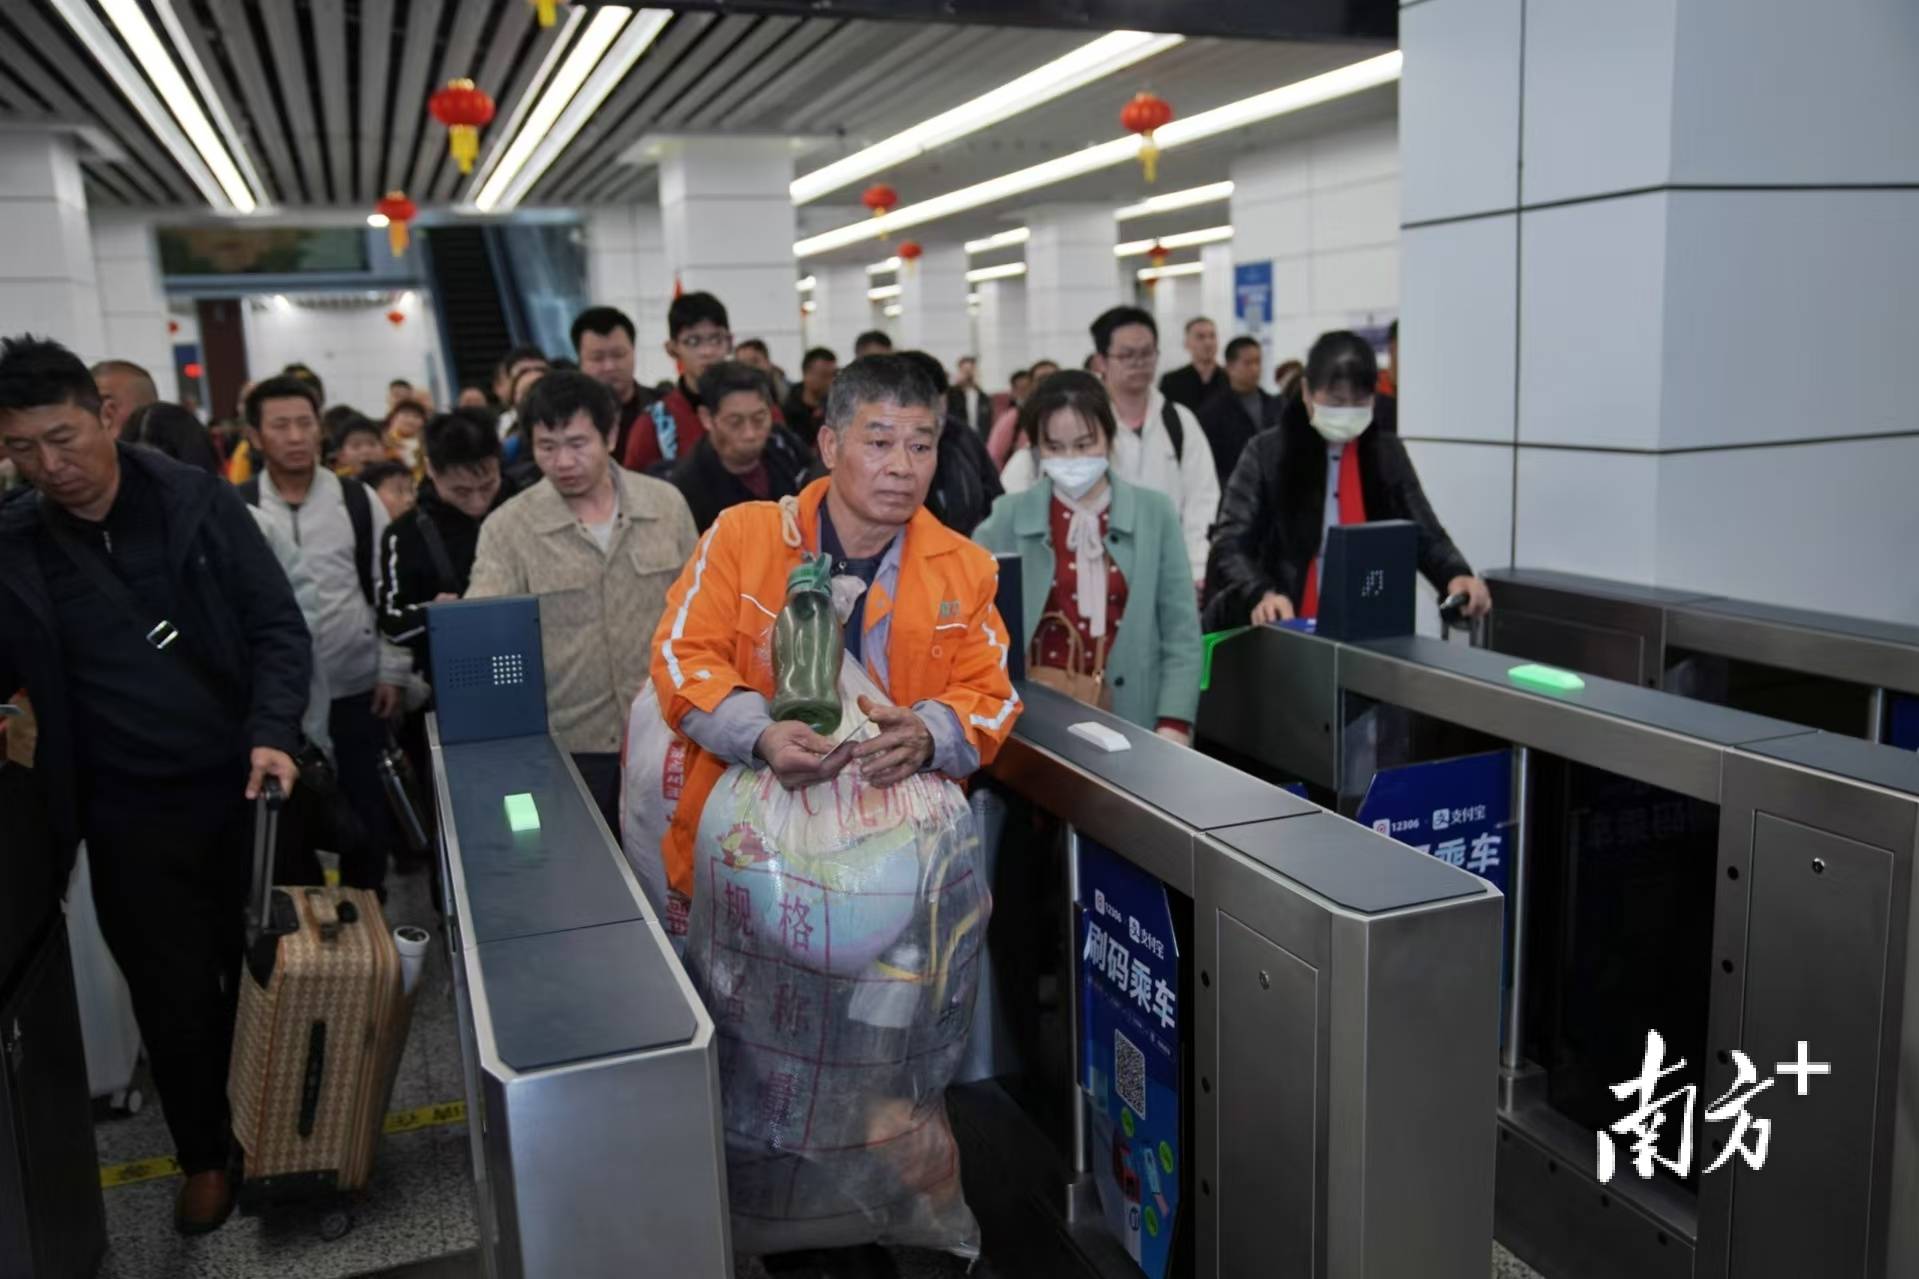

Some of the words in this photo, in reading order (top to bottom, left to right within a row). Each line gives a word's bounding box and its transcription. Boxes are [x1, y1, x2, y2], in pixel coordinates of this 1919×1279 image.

[1391, 818, 1420, 832] 12306
[1450, 804, 1486, 824] 支付宝
[1414, 831, 1503, 874] 乘车
[724, 879, 814, 952] 规格
[1139, 927, 1166, 961] 支付宝
[1083, 921, 1177, 1030] 刷码乘车
